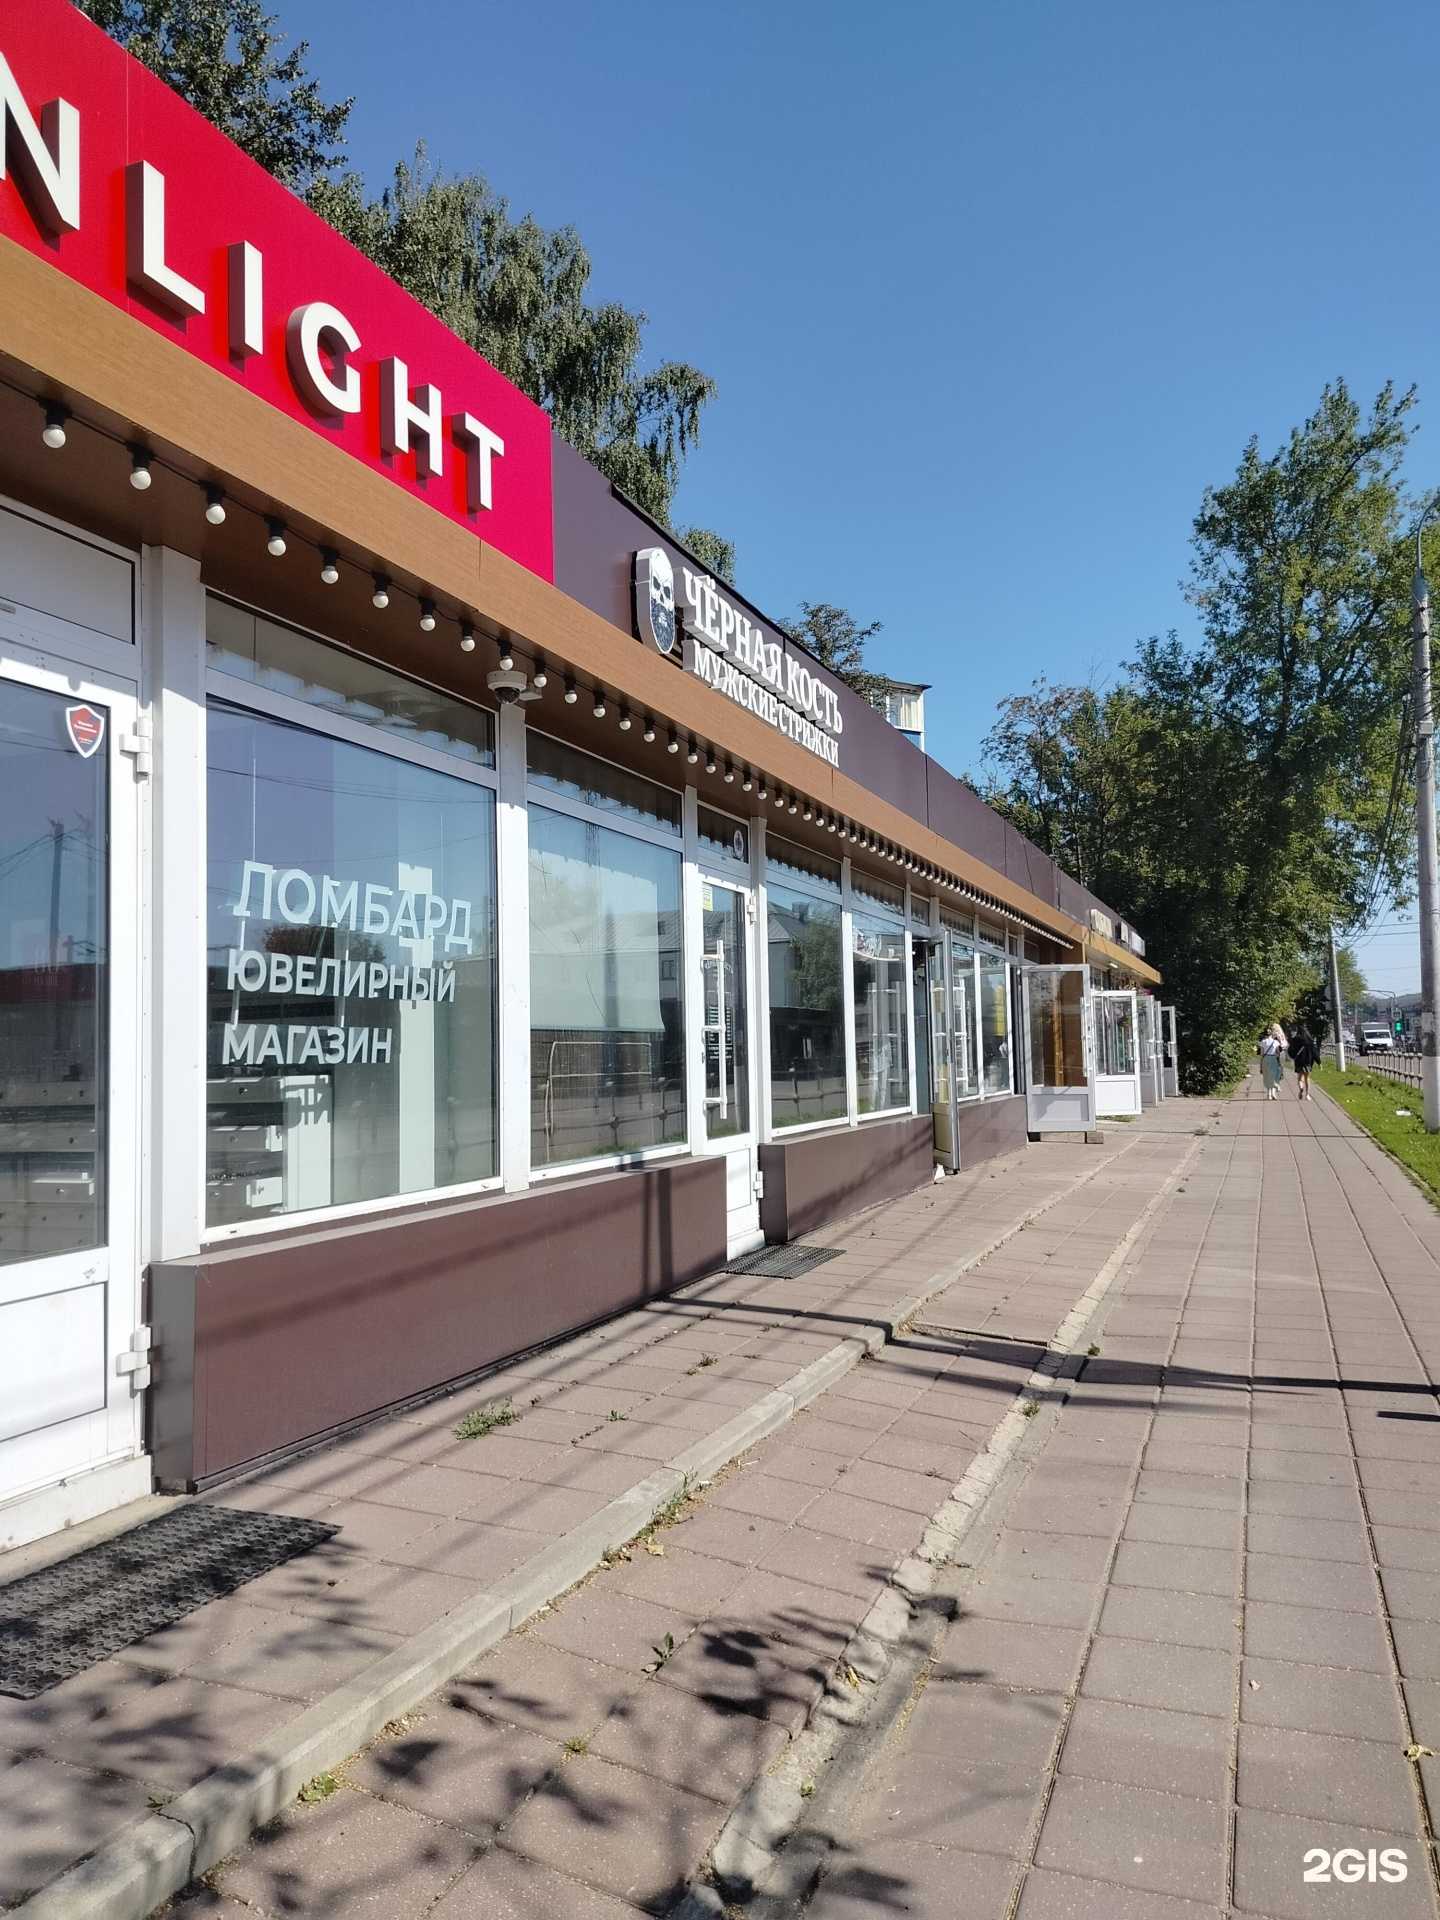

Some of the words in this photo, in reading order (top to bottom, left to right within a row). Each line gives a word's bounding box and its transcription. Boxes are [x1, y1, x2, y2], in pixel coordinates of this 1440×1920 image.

[682, 566, 784, 692] ЧЁРНАЯ
[785, 653, 843, 735] КОСТЬ
[692, 639, 778, 728] МУЖСКИЕ
[233, 861, 473, 955] ЛОМБАРД
[227, 949, 456, 1003] ЮВЕЛИРНЫЙ
[222, 1023, 392, 1066] МАГАЗИН
